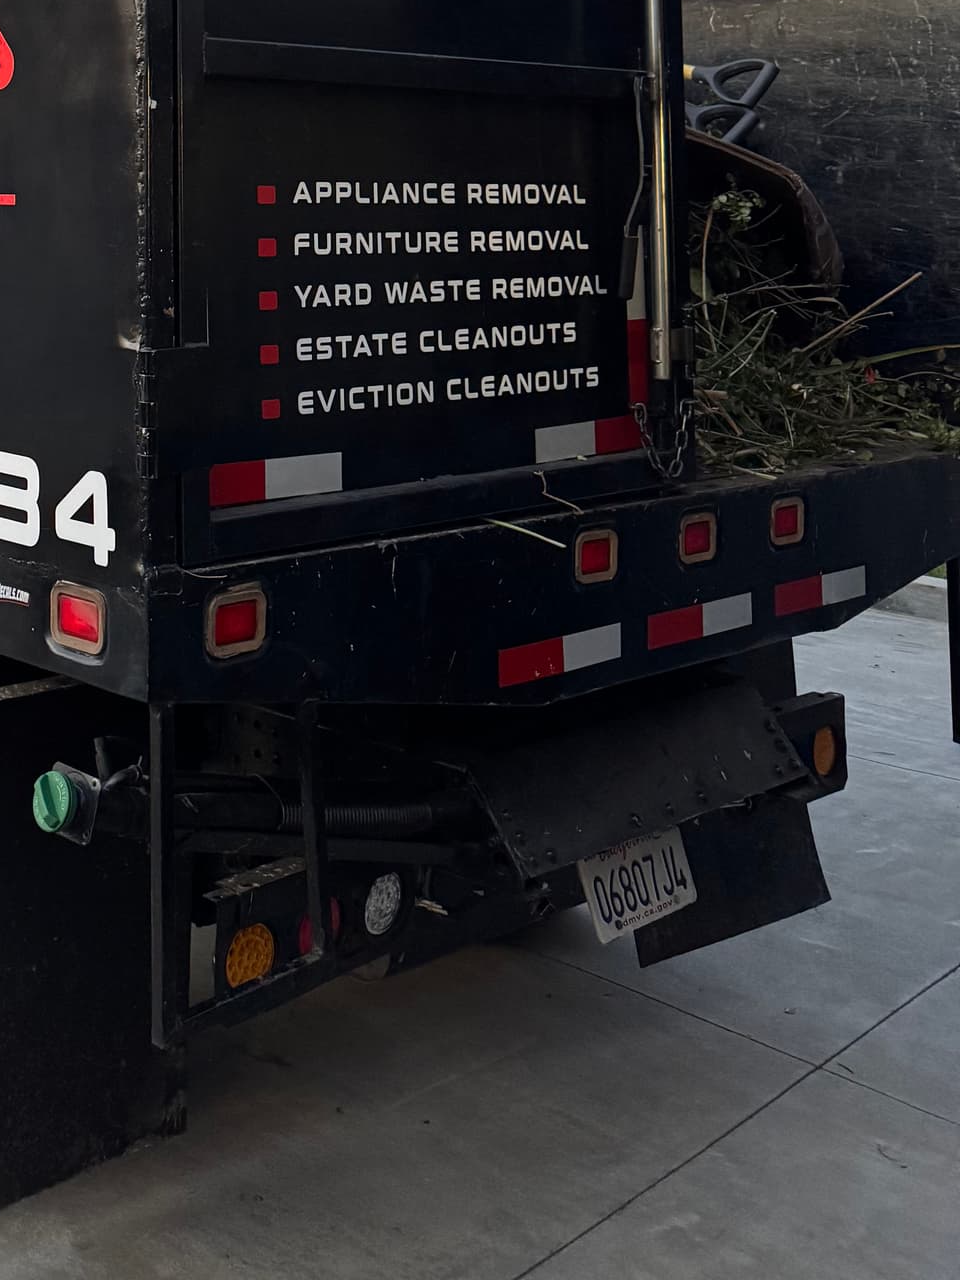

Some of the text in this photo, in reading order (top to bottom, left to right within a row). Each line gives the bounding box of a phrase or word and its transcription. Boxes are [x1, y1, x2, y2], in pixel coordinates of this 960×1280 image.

[292, 181, 587, 205] APPLIANCE REMOVAL
[294, 229, 589, 256] FURNITURE REMOVAL
[294, 274, 608, 308] YARD WASTE REMOVAL
[296, 321, 577, 361] ESTATE CLEANOUTS
[297, 366, 600, 415] EVICTION CLEANOUTS
[623, 898, 674, 928] dmv.ca.gov
